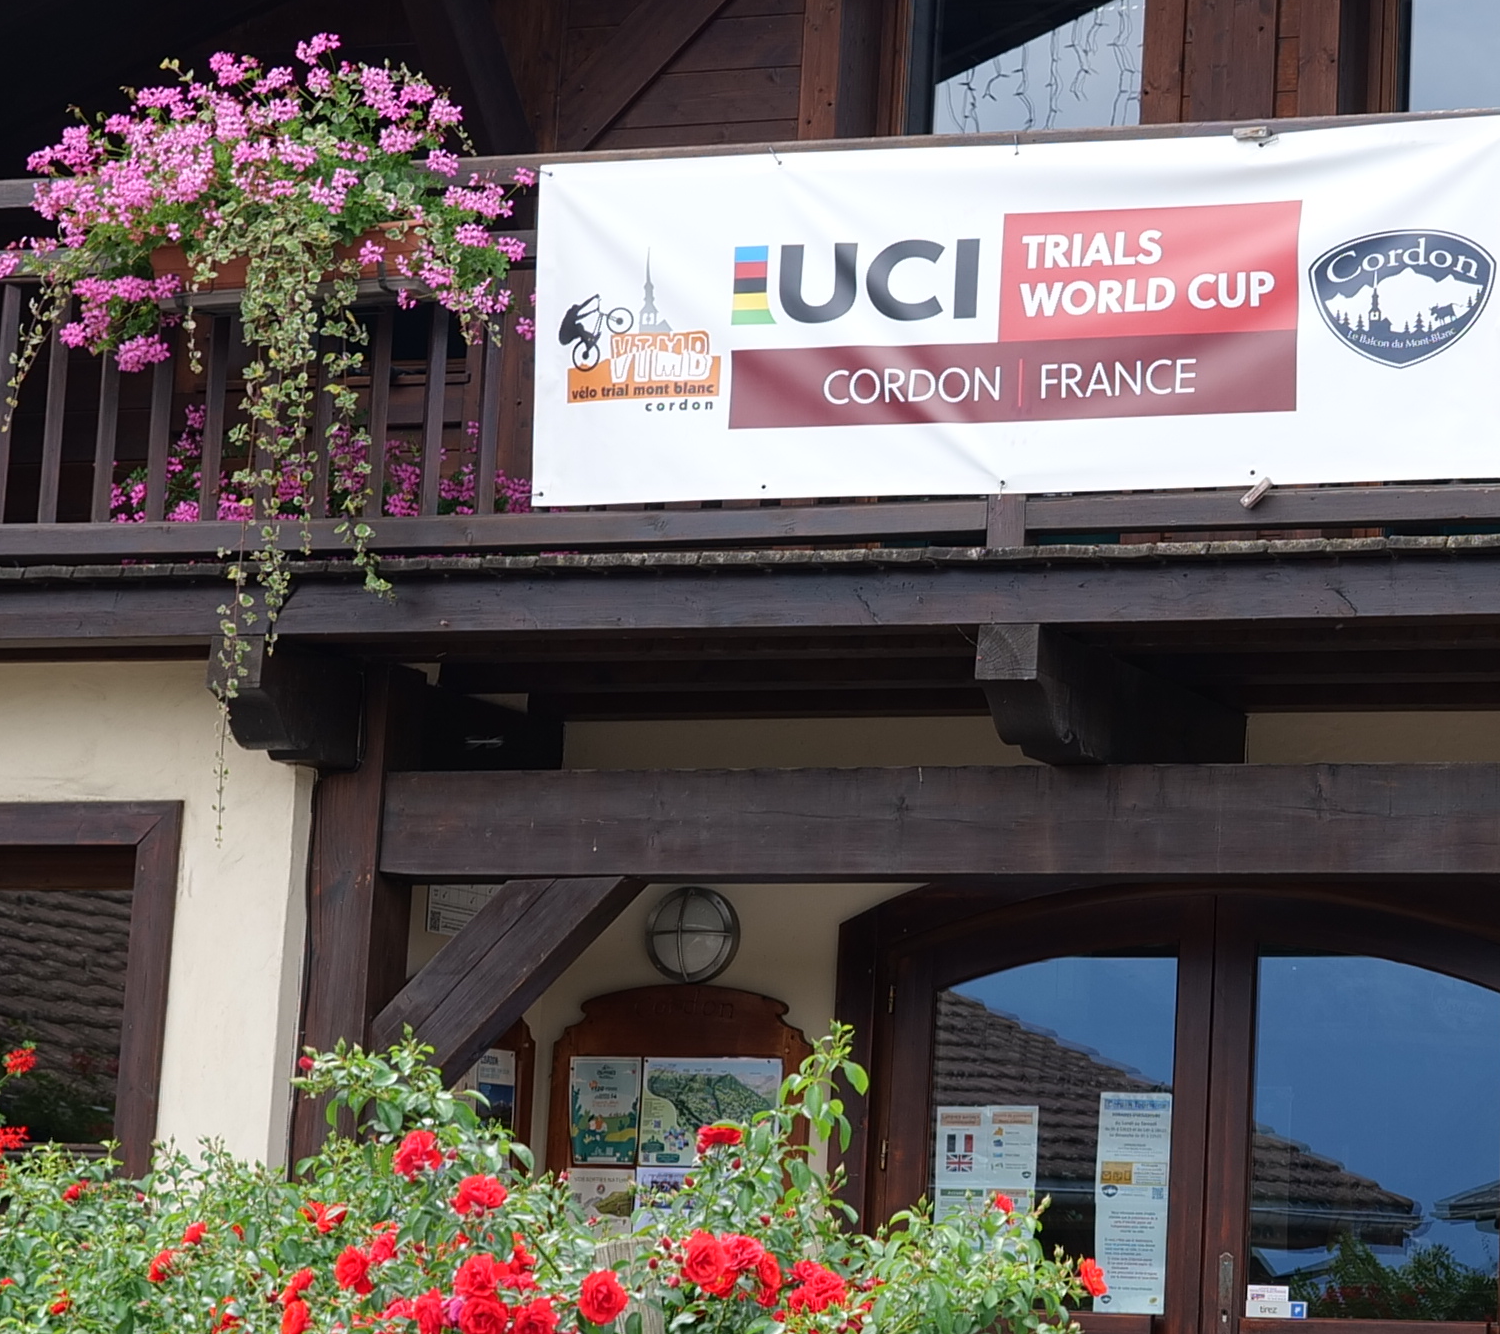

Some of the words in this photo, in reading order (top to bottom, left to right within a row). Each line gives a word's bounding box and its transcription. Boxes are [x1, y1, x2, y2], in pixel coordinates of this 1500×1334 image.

[1021, 229, 1164, 270] TRIALS
[1326, 237, 1478, 284] Cordon
[778, 237, 981, 324] UCI
[1019, 275, 1176, 318] WORLD
[1187, 270, 1276, 311] CUP
[1347, 330, 1359, 342] Le
[1359, 334, 1391, 349] Balcon
[1391, 338, 1404, 349] du
[1405, 327, 1457, 348] Mont-Blanc
[572, 385, 597, 399] vélo
[601, 383, 629, 397] trial
[633, 383, 670, 396] mont
[674, 381, 714, 395] blanc
[822, 365, 1002, 406] CORDON
[1040, 358, 1198, 400] FRANCE
[645, 399, 714, 412] cordon
